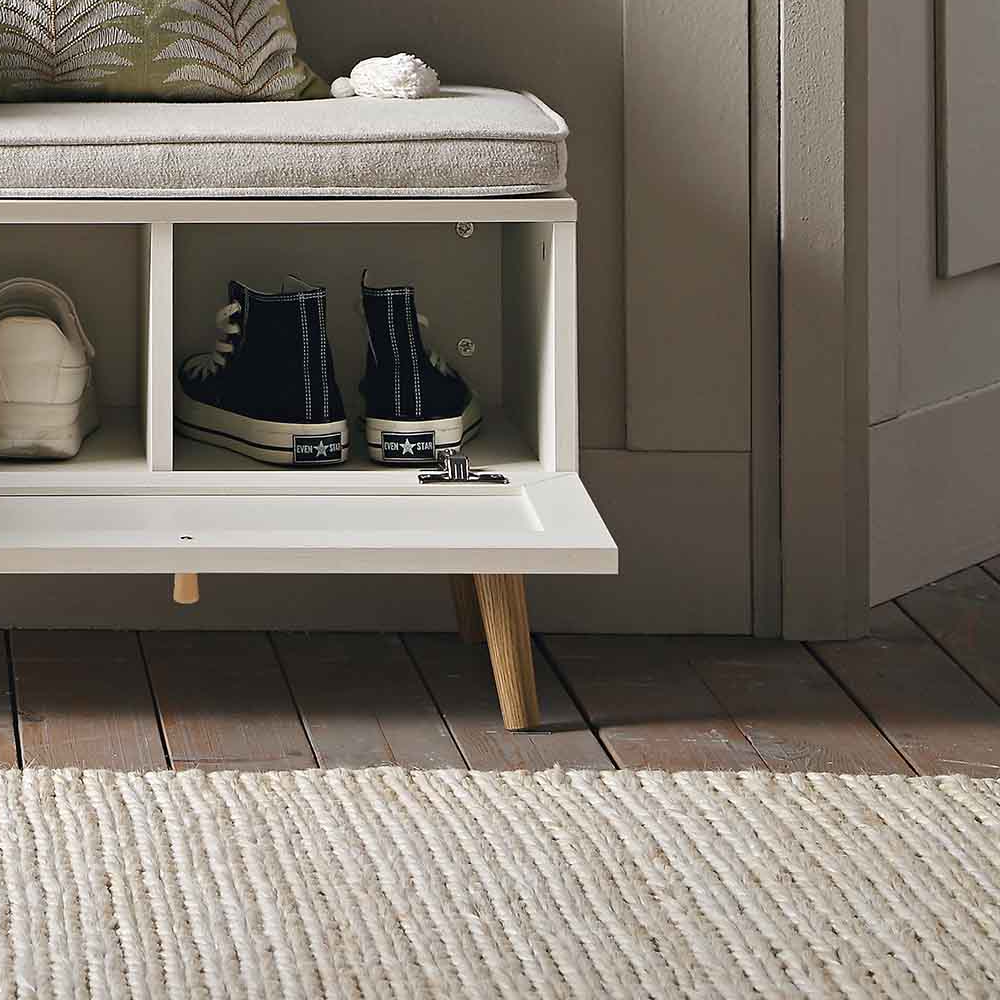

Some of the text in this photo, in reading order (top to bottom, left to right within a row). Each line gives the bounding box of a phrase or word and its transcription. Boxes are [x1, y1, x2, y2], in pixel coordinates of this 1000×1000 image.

[296, 445, 313, 454] EVEN
[384, 442, 433, 451] EVEN STAR
